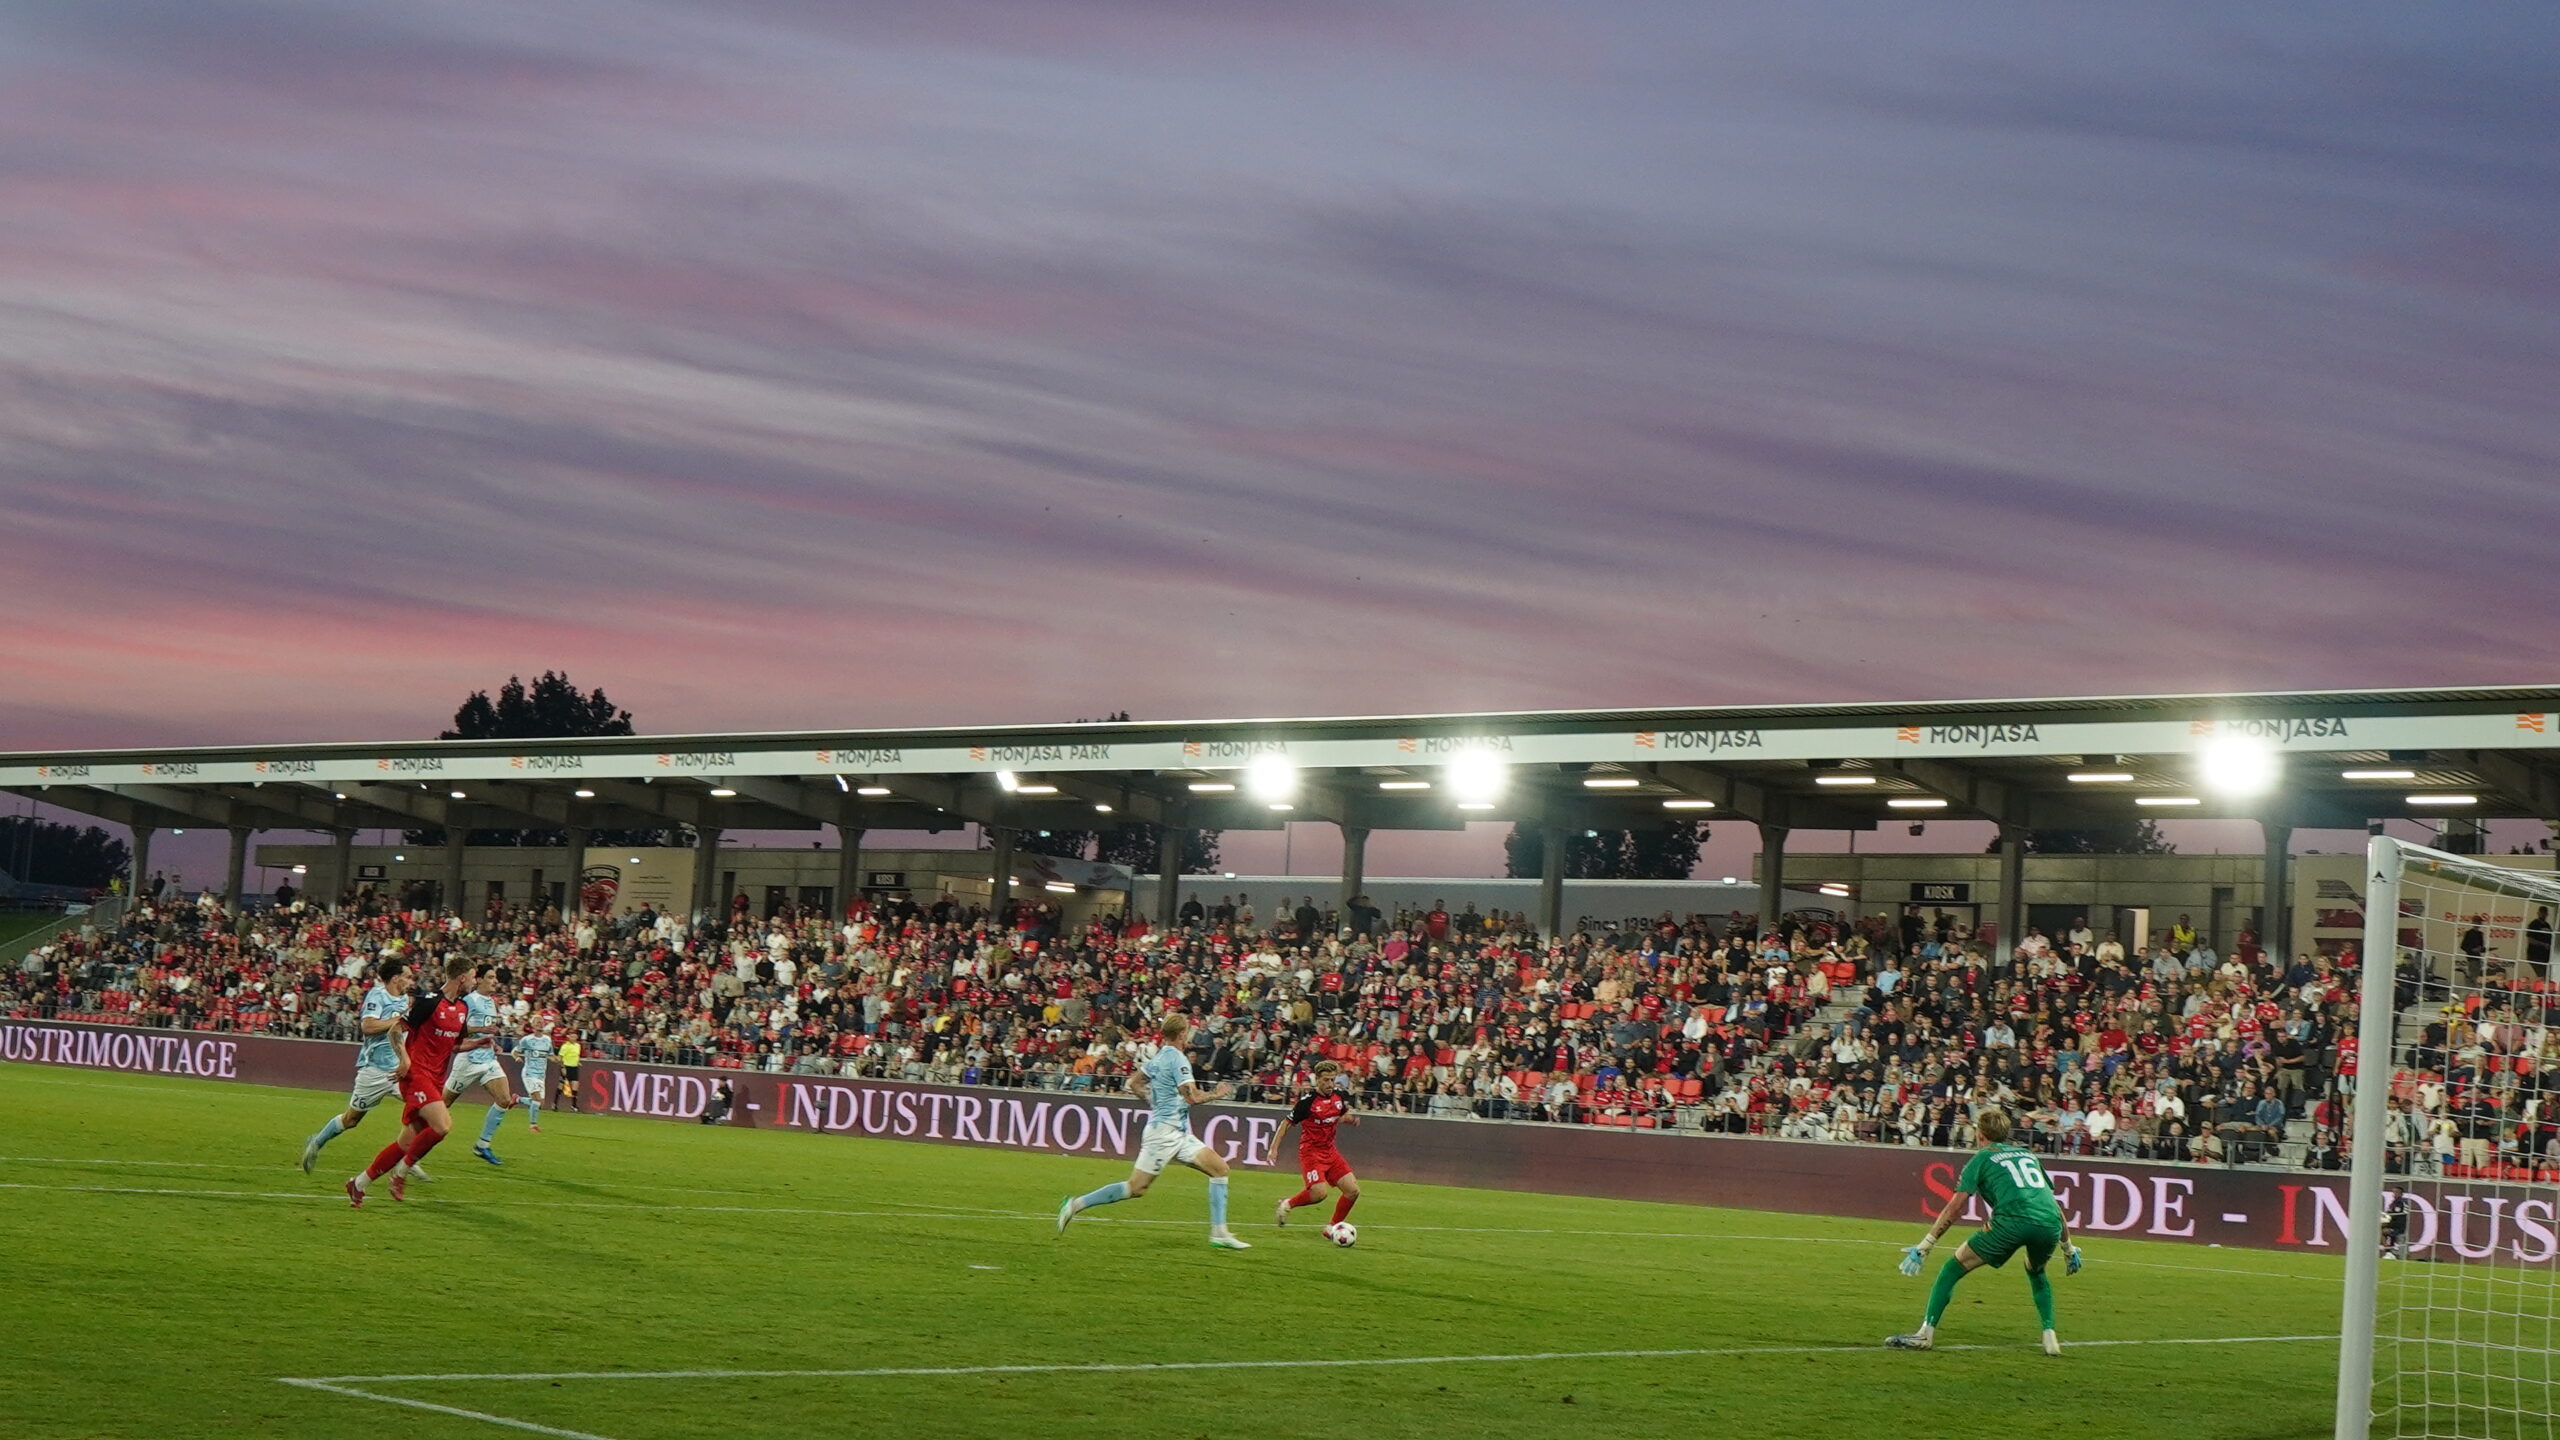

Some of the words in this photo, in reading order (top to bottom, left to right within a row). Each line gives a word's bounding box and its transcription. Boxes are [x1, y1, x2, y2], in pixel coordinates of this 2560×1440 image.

[1931, 724, 2040, 748] MONJASA
[2226, 717, 2348, 743] MONJASA
[1664, 730, 1762, 753] MONJASA
[675, 752, 735, 770] MONJASA
[835, 749, 902, 767] MONJASA
[991, 745, 1063, 765] MONJASA
[1070, 744, 1111, 760] PARK
[269, 761, 316, 776] MONJASA
[393, 758, 443, 774] MONJASA
[527, 755, 583, 772] MONJASA
[1924, 885, 1955, 899] KIOSK
[452, 1080, 464, 1092] 12
[353, 1095, 367, 1109] 26
[1152, 1158, 1164, 1172] 5
[1999, 1157, 2045, 1189] 16
[1306, 1169, 1320, 1183] 98
[1919, 1162, 2195, 1237] SEDE
